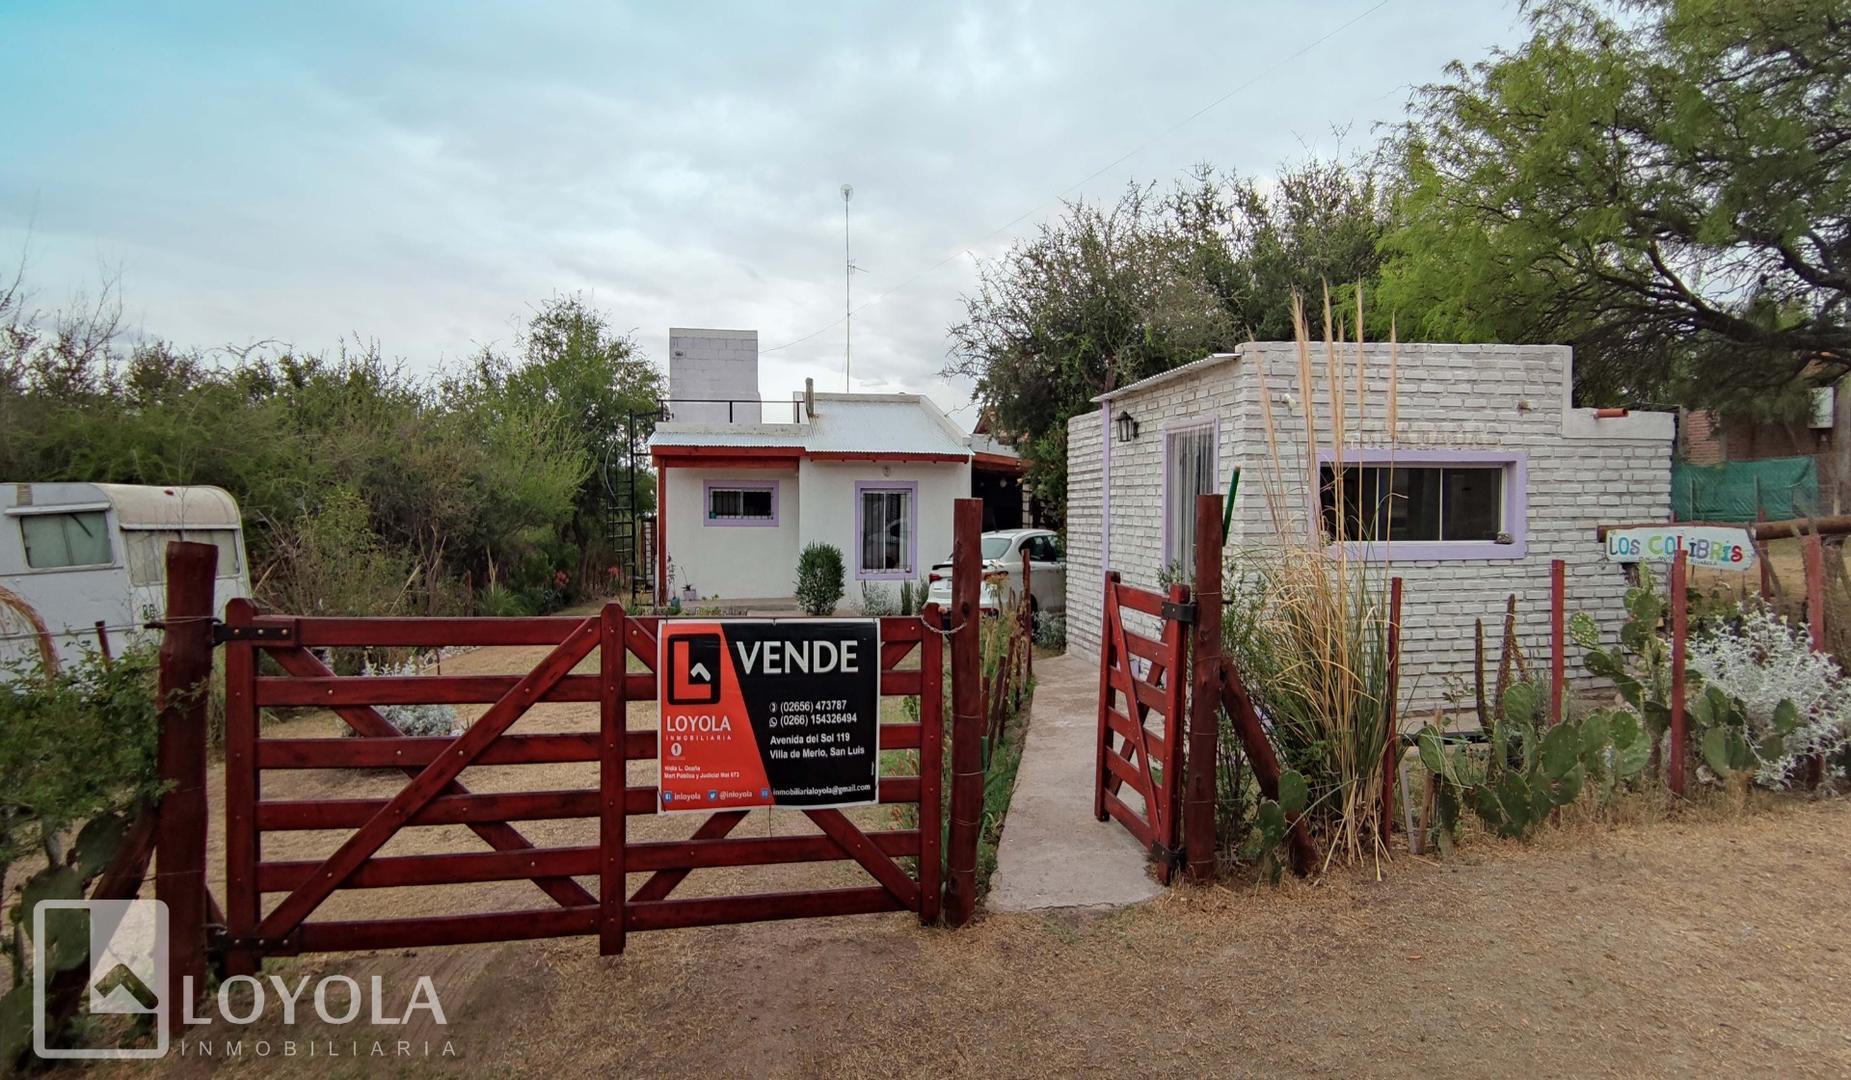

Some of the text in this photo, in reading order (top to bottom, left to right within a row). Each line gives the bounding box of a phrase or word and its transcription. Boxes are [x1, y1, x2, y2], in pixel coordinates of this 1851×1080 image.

[1609, 536, 1640, 555] LOS
[736, 640, 859, 674] VENDE
[780, 700, 847, 713] (02656) 473787
[666, 715, 731, 732] LOYOLA
[780, 712, 857, 728] (0266) 154326494
[770, 732, 850, 745] Avenida del Sol 119
[769, 745, 865, 759] Villa de Merlo, San Luis
[773, 784, 871, 796] inmobiliarialoyola@gmail.com
